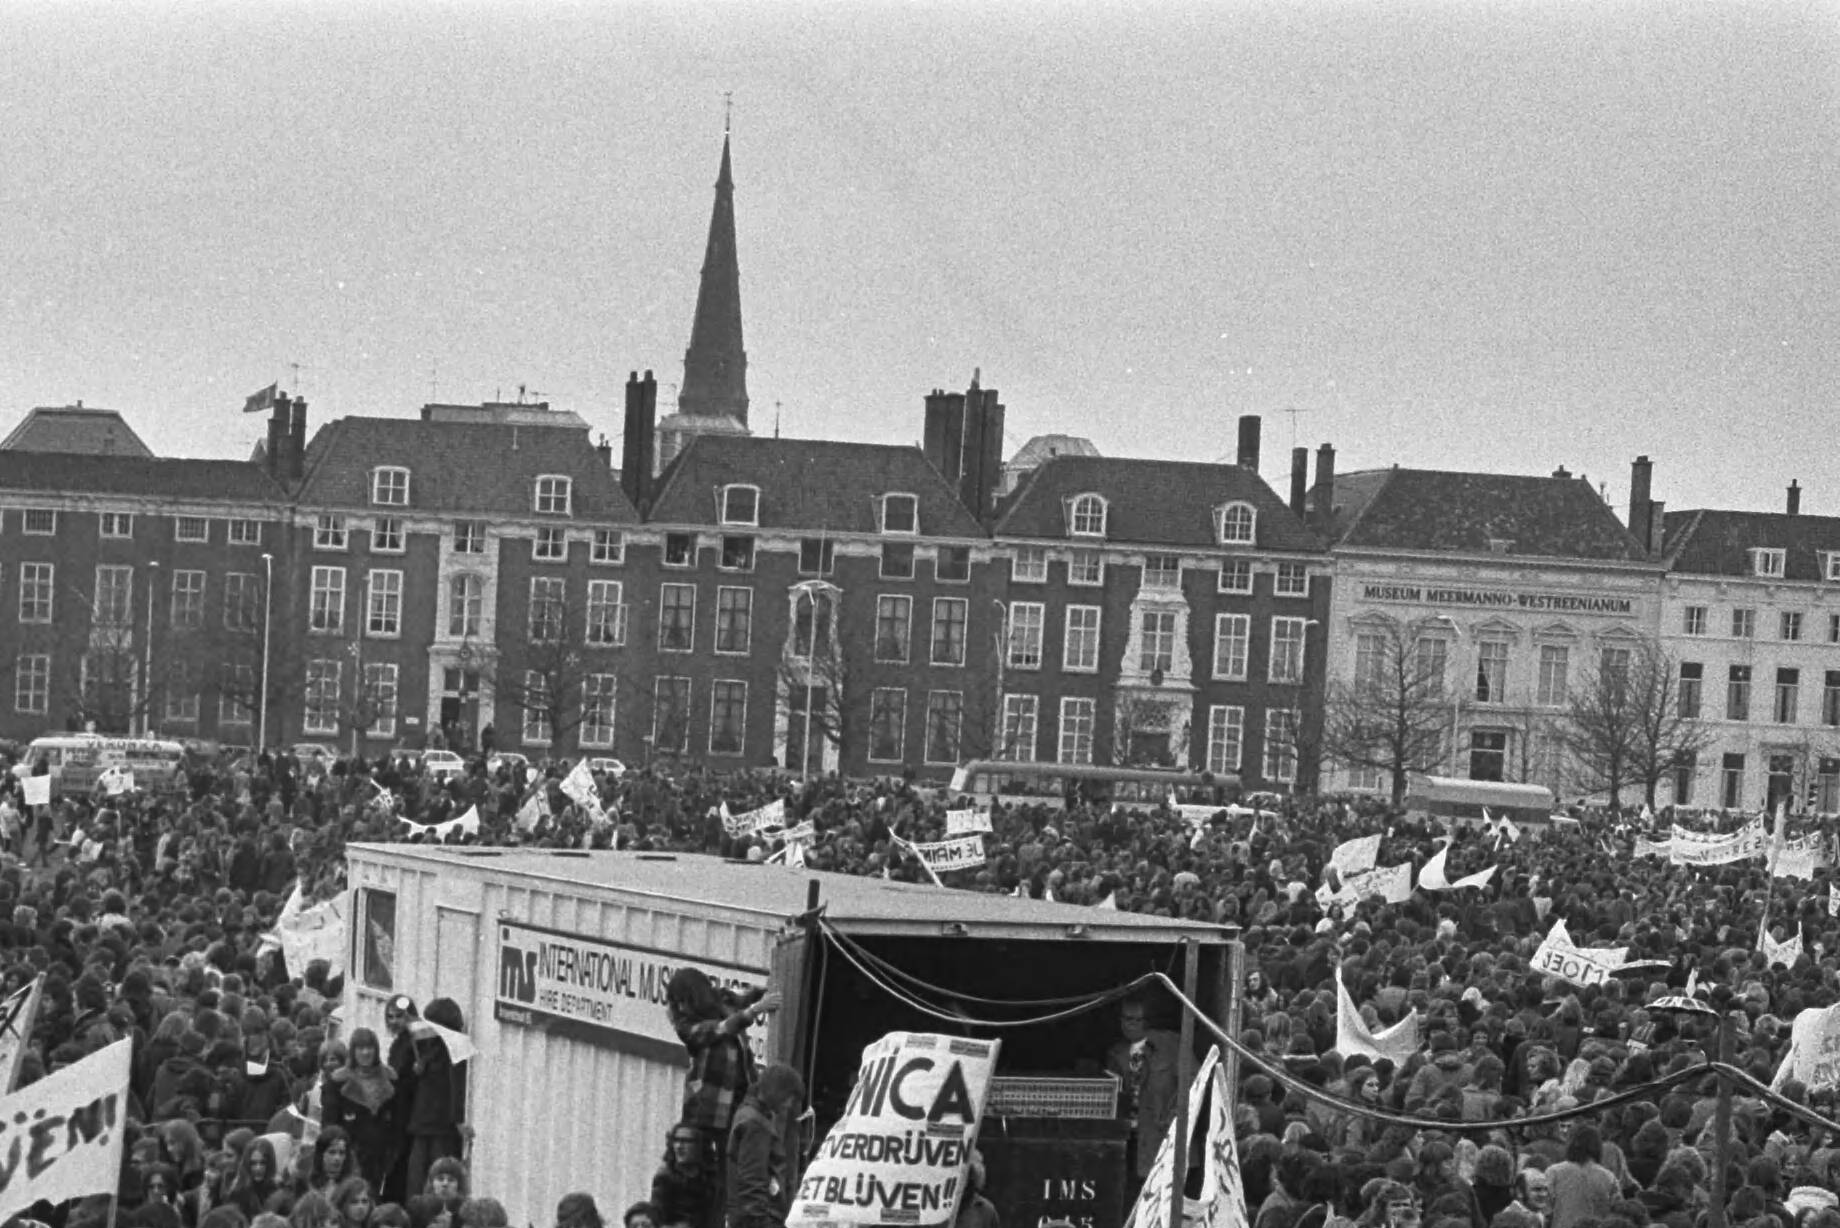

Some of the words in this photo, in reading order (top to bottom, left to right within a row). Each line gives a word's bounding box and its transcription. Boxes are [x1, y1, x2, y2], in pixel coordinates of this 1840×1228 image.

[1364, 585, 1421, 601] MUSEUM
[1426, 589, 1631, 613] MEERMANNO-WESTREENIANUM
[538, 941, 637, 999] INTERNATIONAL
[1043, 1179, 1097, 1201] IMS
